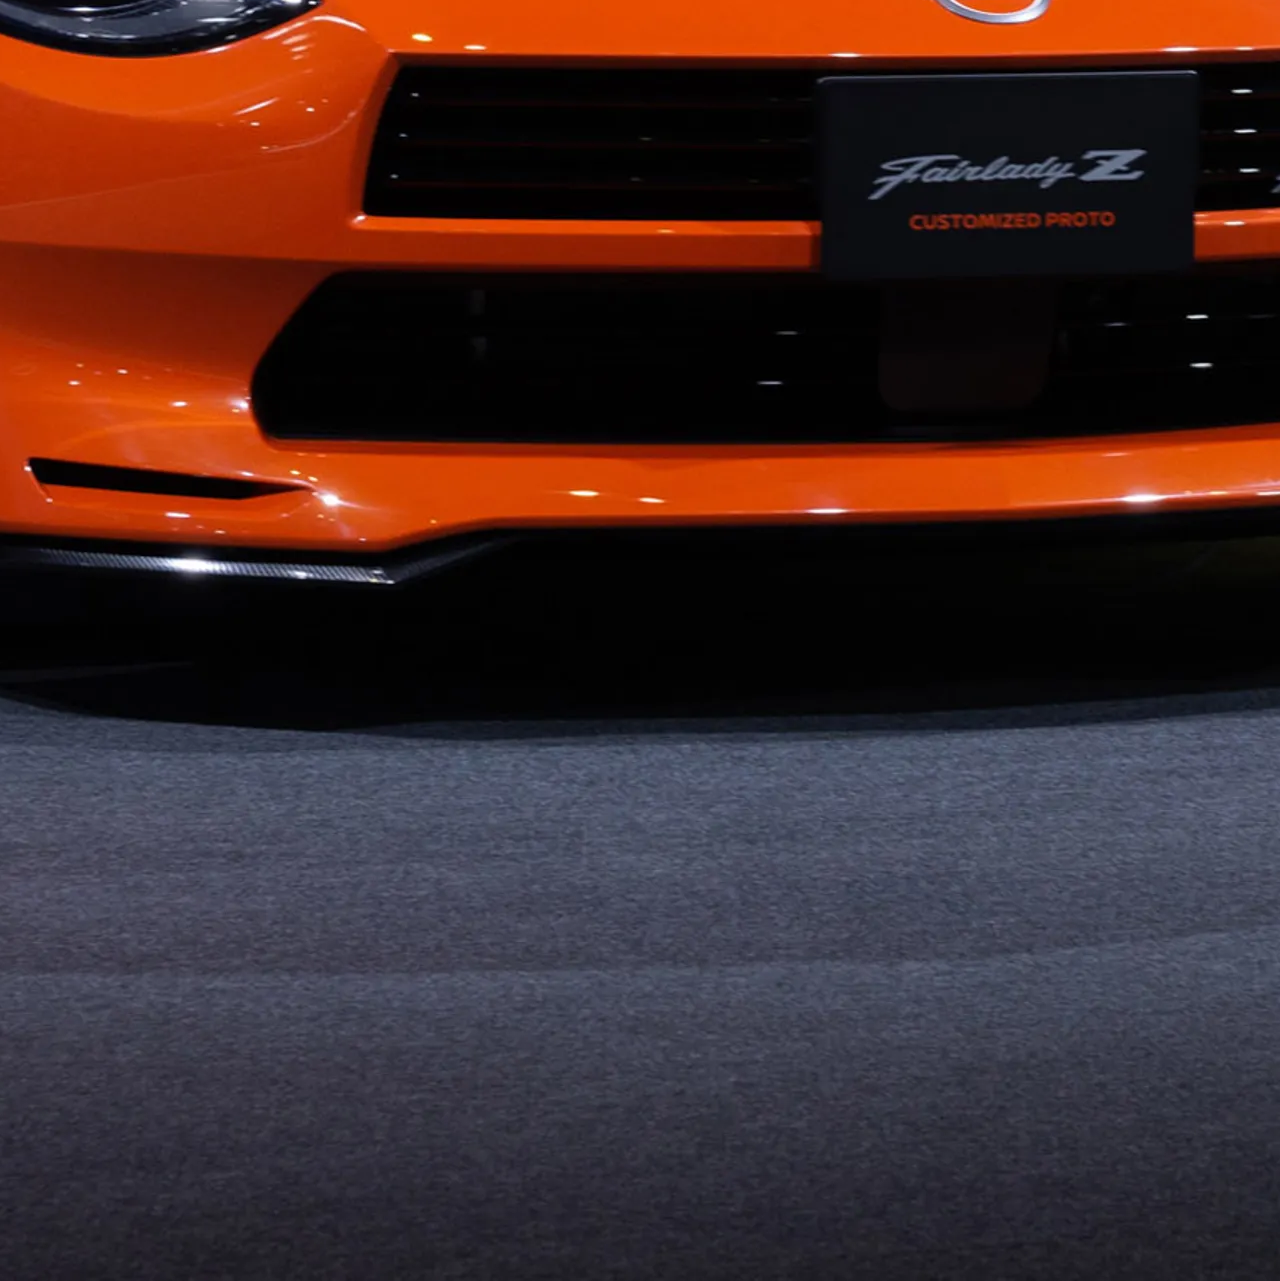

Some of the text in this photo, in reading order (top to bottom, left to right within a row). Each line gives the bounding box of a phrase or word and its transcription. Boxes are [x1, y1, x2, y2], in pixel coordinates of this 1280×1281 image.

[867, 148, 1147, 201] Fairlady Z
[909, 211, 1116, 230] CUSTOMIZED PROTO
